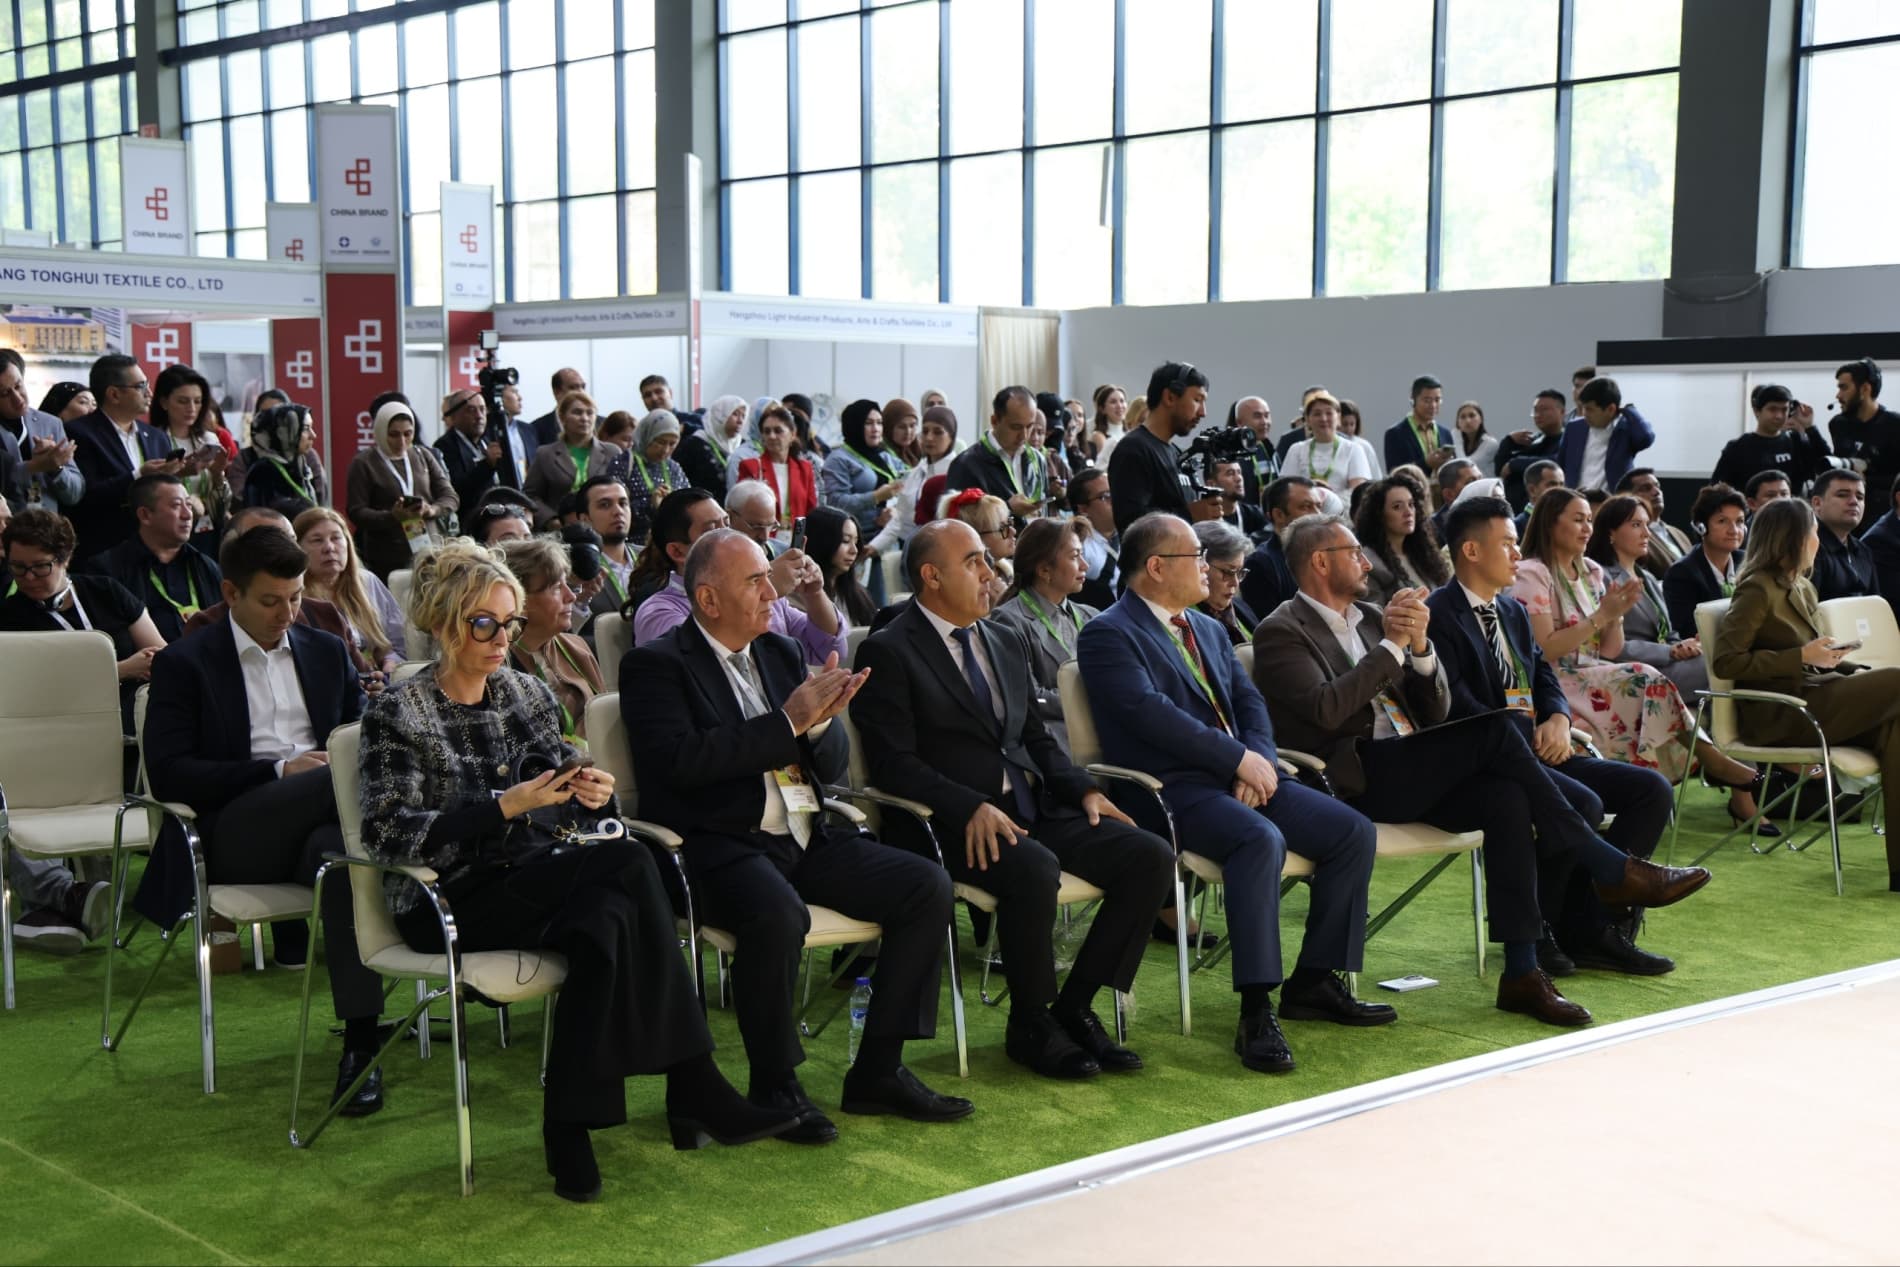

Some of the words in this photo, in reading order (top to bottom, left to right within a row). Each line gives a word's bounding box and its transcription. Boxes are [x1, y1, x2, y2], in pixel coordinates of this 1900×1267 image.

[330, 208, 358, 217] CHINA
[358, 208, 389, 217] BRAND
[0, 267, 26, 281] NG
[30, 268, 99, 285] TONGHUI
[103, 273, 161, 288] TEXTILE
[166, 276, 194, 291] CO.,
[198, 278, 224, 291] LTD
